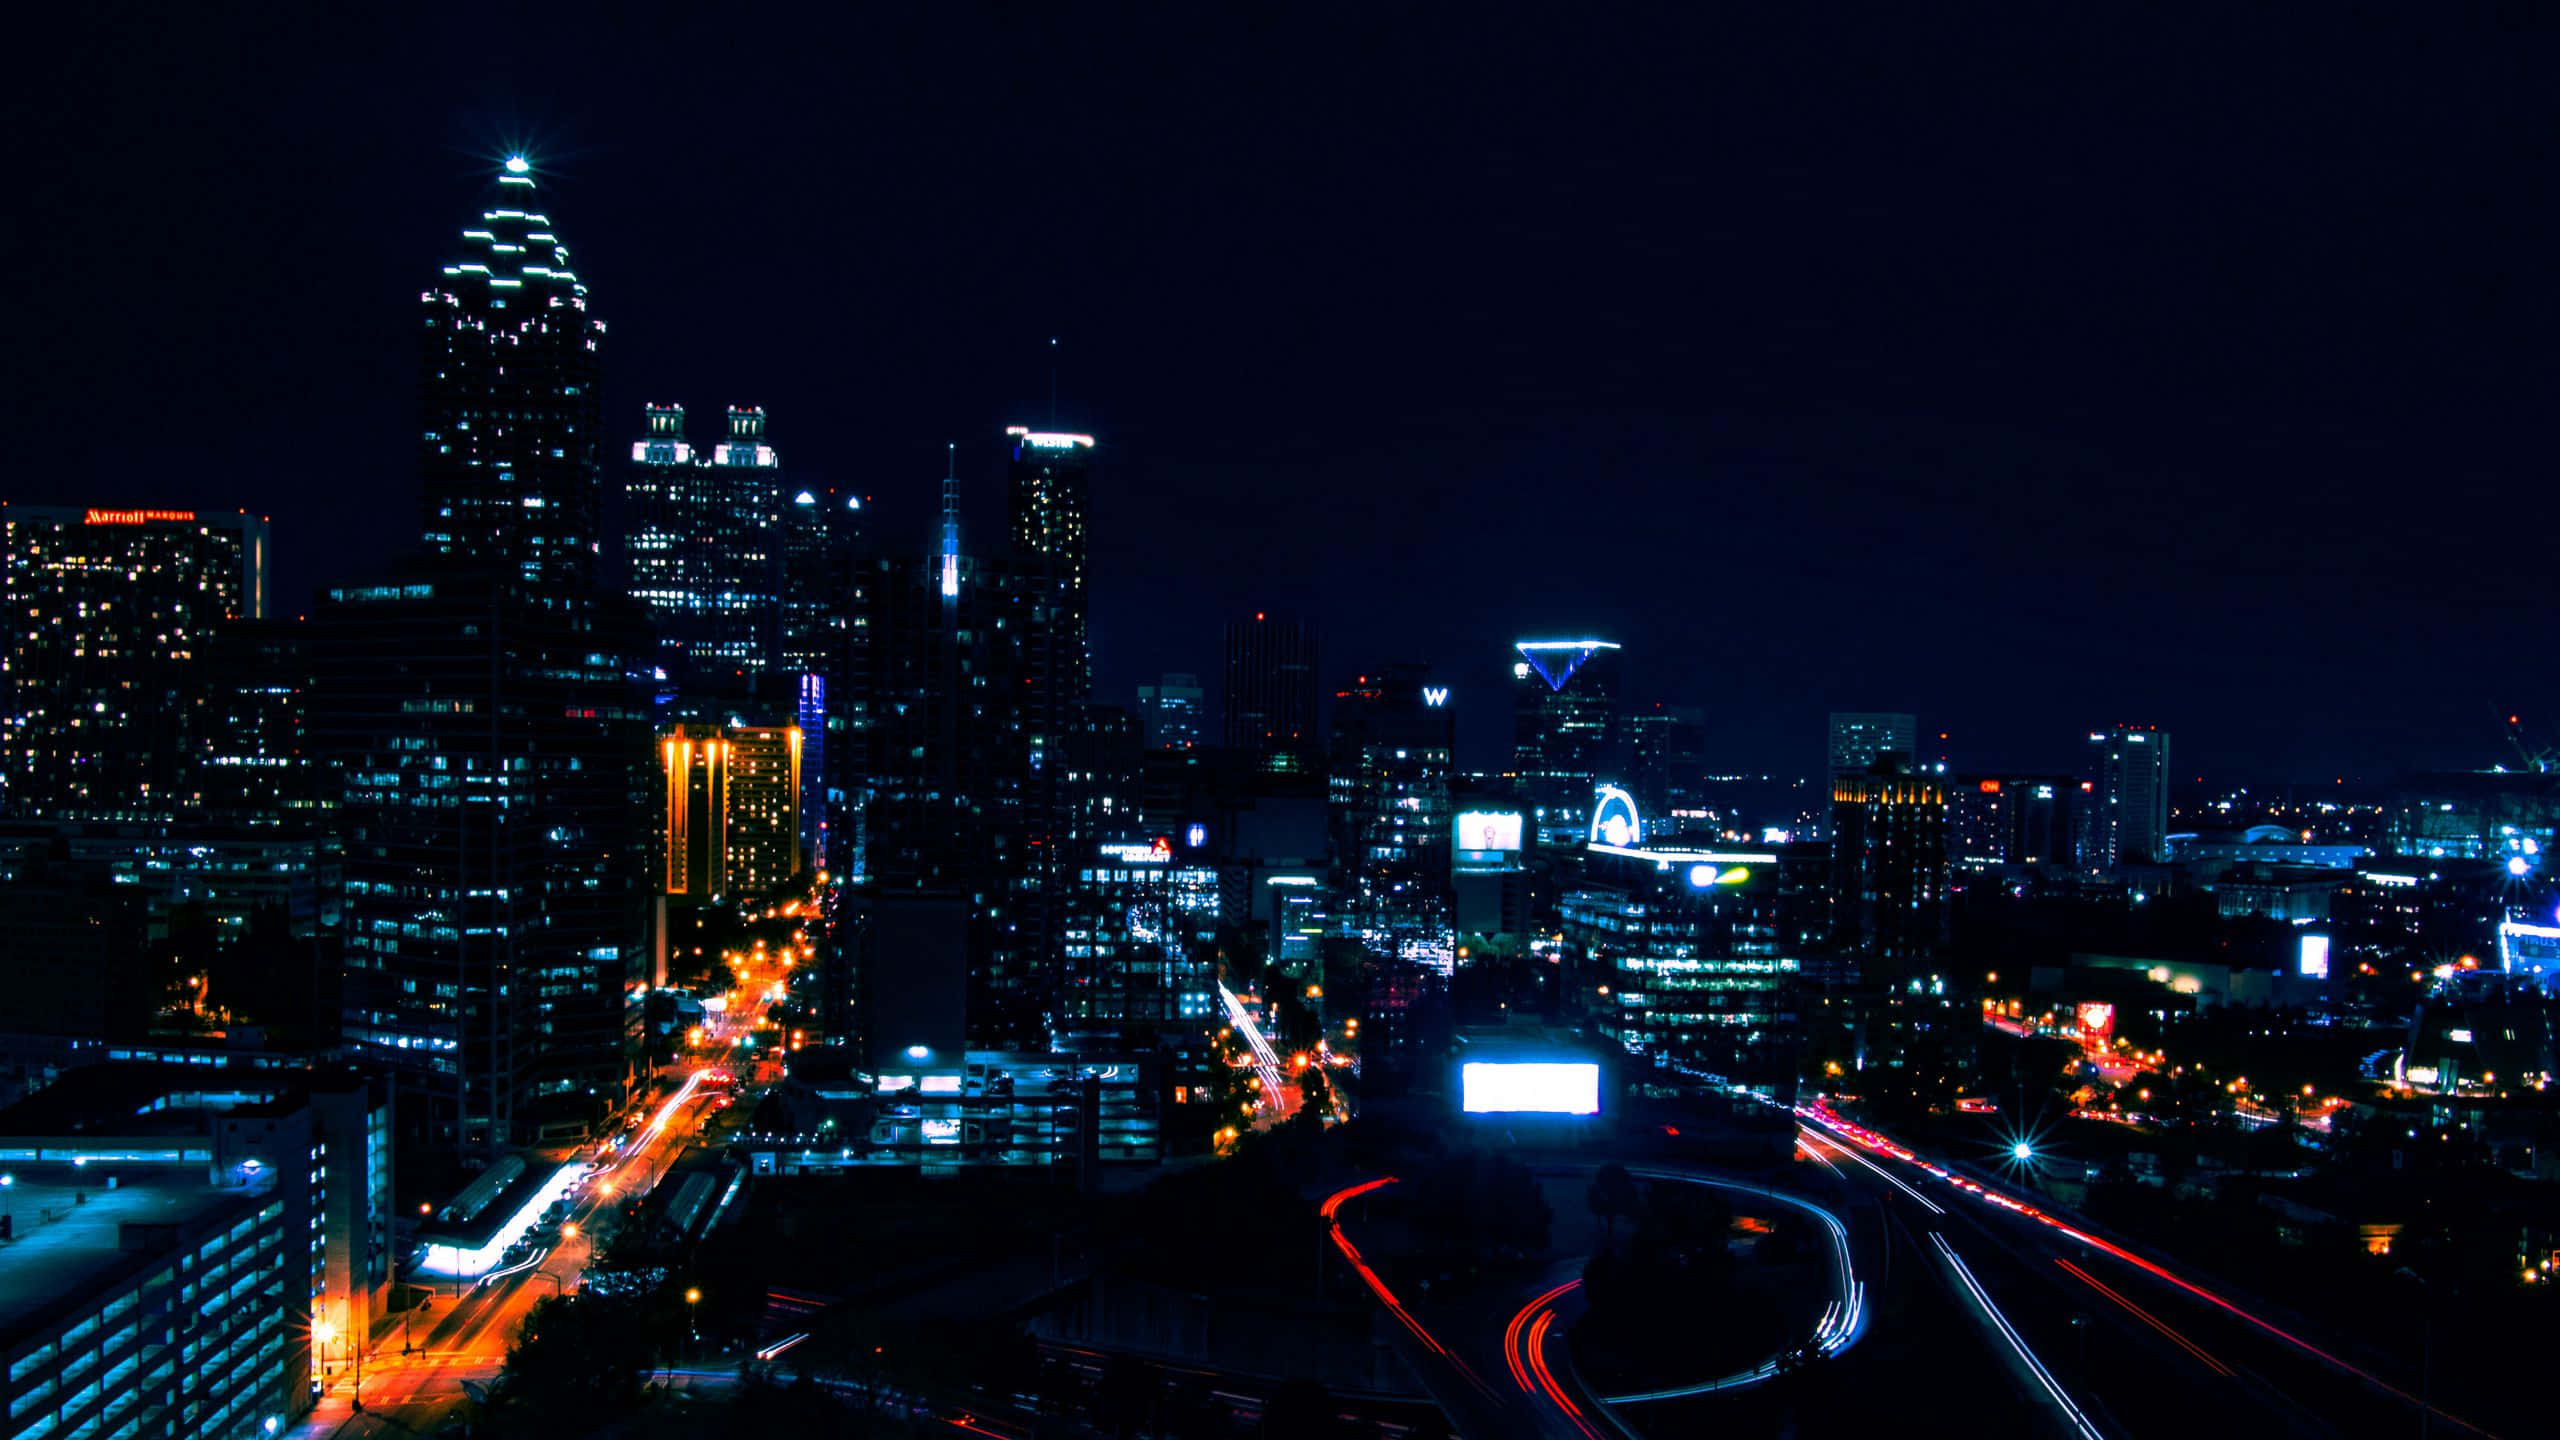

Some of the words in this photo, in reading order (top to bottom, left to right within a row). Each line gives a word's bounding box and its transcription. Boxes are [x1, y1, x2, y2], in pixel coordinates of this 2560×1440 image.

[85, 508, 145, 526] Marriott
[146, 510, 195, 521] MARQUIS
[1423, 687, 1448, 707] W
[1980, 780, 2000, 792] CNN
